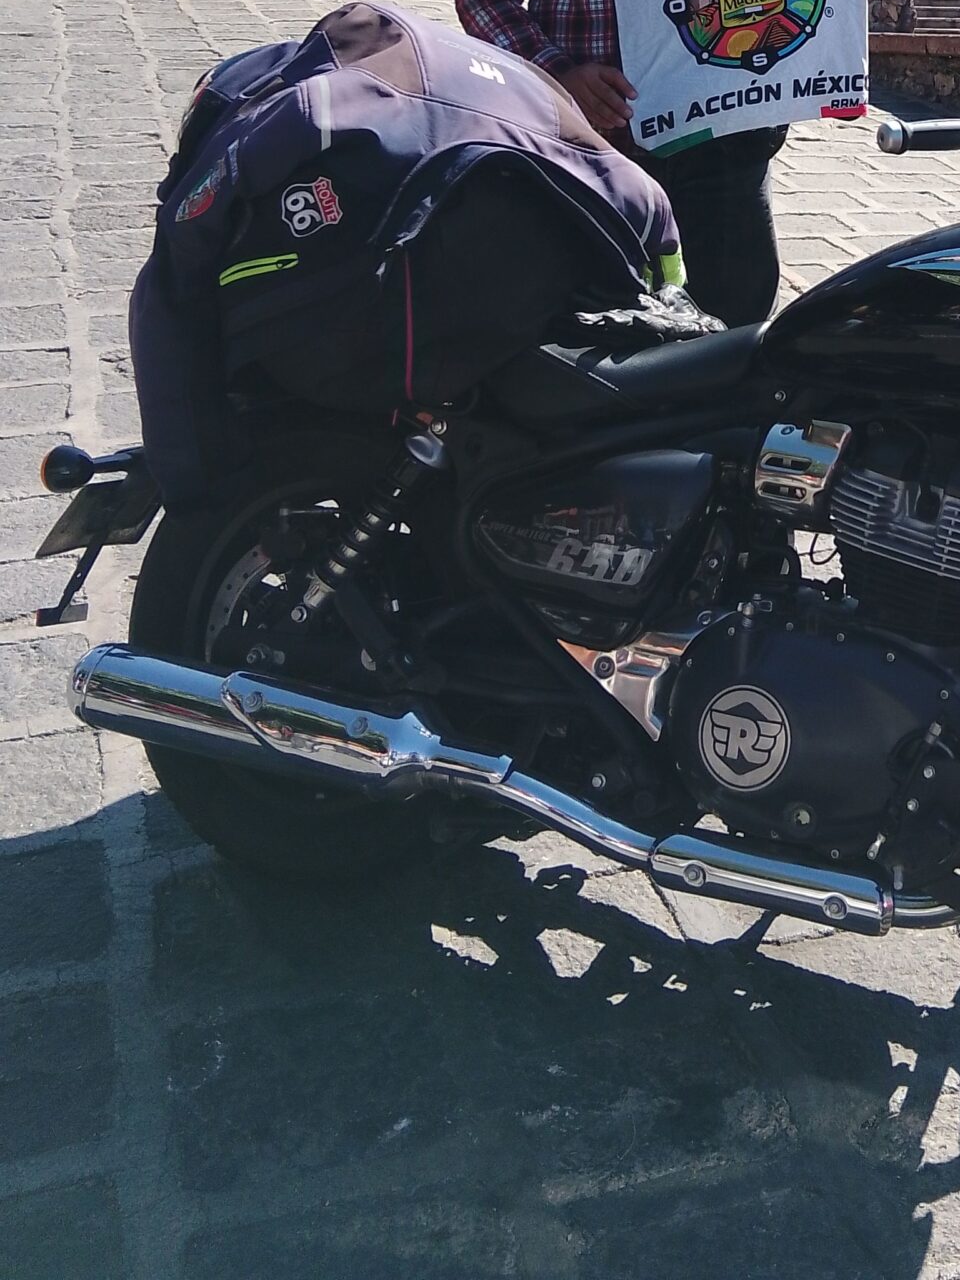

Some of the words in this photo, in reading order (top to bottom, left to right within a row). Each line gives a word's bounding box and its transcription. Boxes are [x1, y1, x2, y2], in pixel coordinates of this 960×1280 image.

[669, 0, 686, 14] O
[752, 53, 768, 67] S
[640, 111, 675, 139] EN
[685, 79, 782, 123] ACCIÓN
[830, 98, 860, 110] RRM
[285, 190, 321, 230] 66
[315, 180, 339, 222] ROUTE
[547, 537, 653, 586] 650
